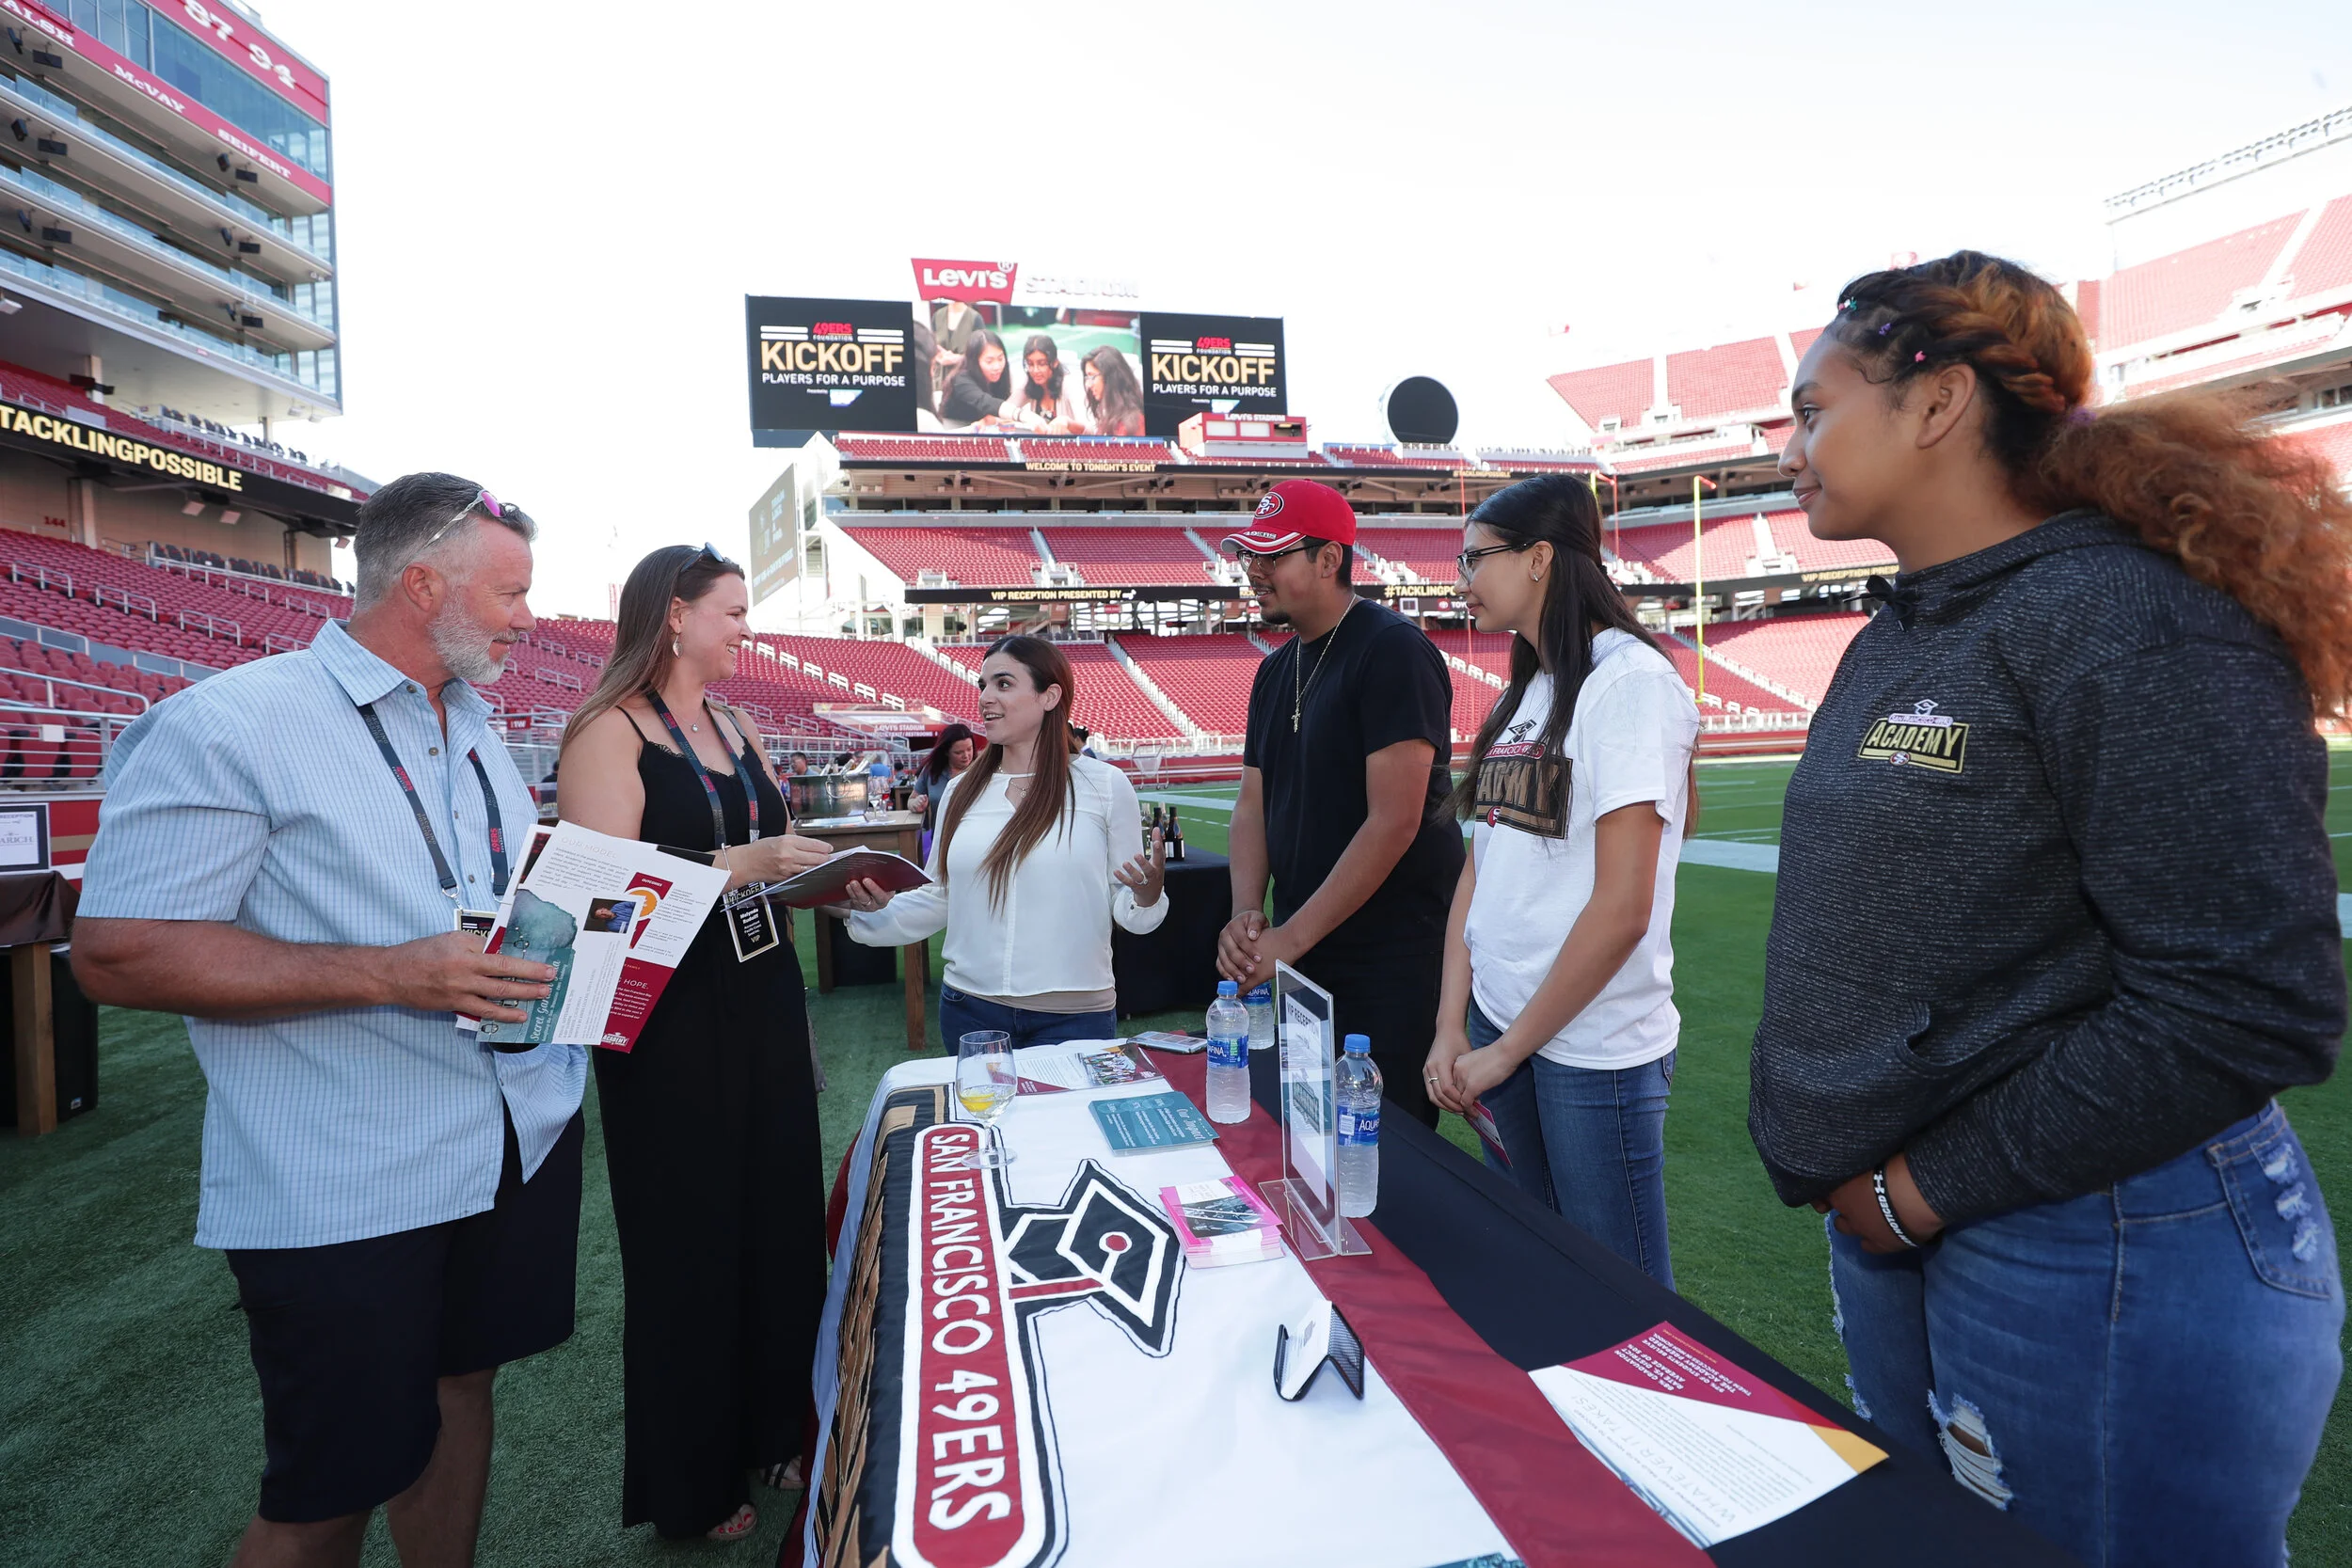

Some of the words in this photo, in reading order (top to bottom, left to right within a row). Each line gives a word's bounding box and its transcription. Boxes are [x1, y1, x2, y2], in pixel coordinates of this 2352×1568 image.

[114, 63, 187, 114] McVAY
[217, 128, 292, 180] SEIFERT
[812, 322, 853, 336] 49ERS
[1196, 337, 1232, 349] 49ERS
[761, 341, 905, 373] KICKOFF
[1151, 353, 1277, 386] KICKOFF
[762, 372, 814, 386] PLAYERS
[816, 373, 839, 386] FOR
[841, 374, 851, 386] A
[852, 375, 906, 388] PURPOSE
[1152, 383, 1198, 395] PLAYERS
[1200, 385, 1219, 396] FOR
[1221, 386, 1231, 396] A
[1231, 386, 1278, 398] PURPOSE
[1253, 414, 1286, 422] STADIUM
[1025, 462, 1070, 472] WELCOME
[1070, 463, 1083, 472] TO
[1083, 463, 1129, 472] TONIGHT'S
[1128, 463, 1157, 473] EVENT
[1242, 531, 1278, 541] 49ERS
[1801, 572, 1819, 583] VIP
[1818, 567, 1870, 581] RECEPTION
[991, 591, 1007, 601] VIP
[1008, 591, 1057, 601] RECEPTION
[1057, 590, 1109, 600] PRESENTED
[1109, 589, 1122, 599] BY
[1867, 721, 1963, 757] ACADEMY
[488, 827, 501, 853] 49ERS
[529, 1014, 545, 1041] Secret
[930, 1133, 972, 1174] SAN
[930, 1180, 993, 1355] FRANCISCO
[1643, 1339, 1667, 1356] BELIEVE
[1648, 1336, 1684, 1360] PREPARED
[1654, 1332, 1675, 1349] SCHOOL
[1622, 1349, 1652, 1370] DISTRICT
[1673, 1345, 1686, 1356] HIGH
[1614, 1351, 1658, 1381] GRADUATION
[1652, 1360, 1686, 1383] AVERAGE
[1654, 1368, 1663, 1377] VS.
[1667, 1353, 1701, 1377] STUDENTS
[1684, 1354, 1722, 1383] ACADEMY
[1690, 1356, 1720, 1375] SUCCESS
[1663, 1375, 1684, 1390] RATE
[1699, 1373, 1710, 1383] OF
[1718, 1375, 1733, 1385] FOR
[1720, 1381, 1737, 1394] THE
[1731, 1381, 1752, 1396] THEM
[928, 1370, 1012, 1531] 49ERS
[1635, 1443, 1739, 1523] WHATEVER
